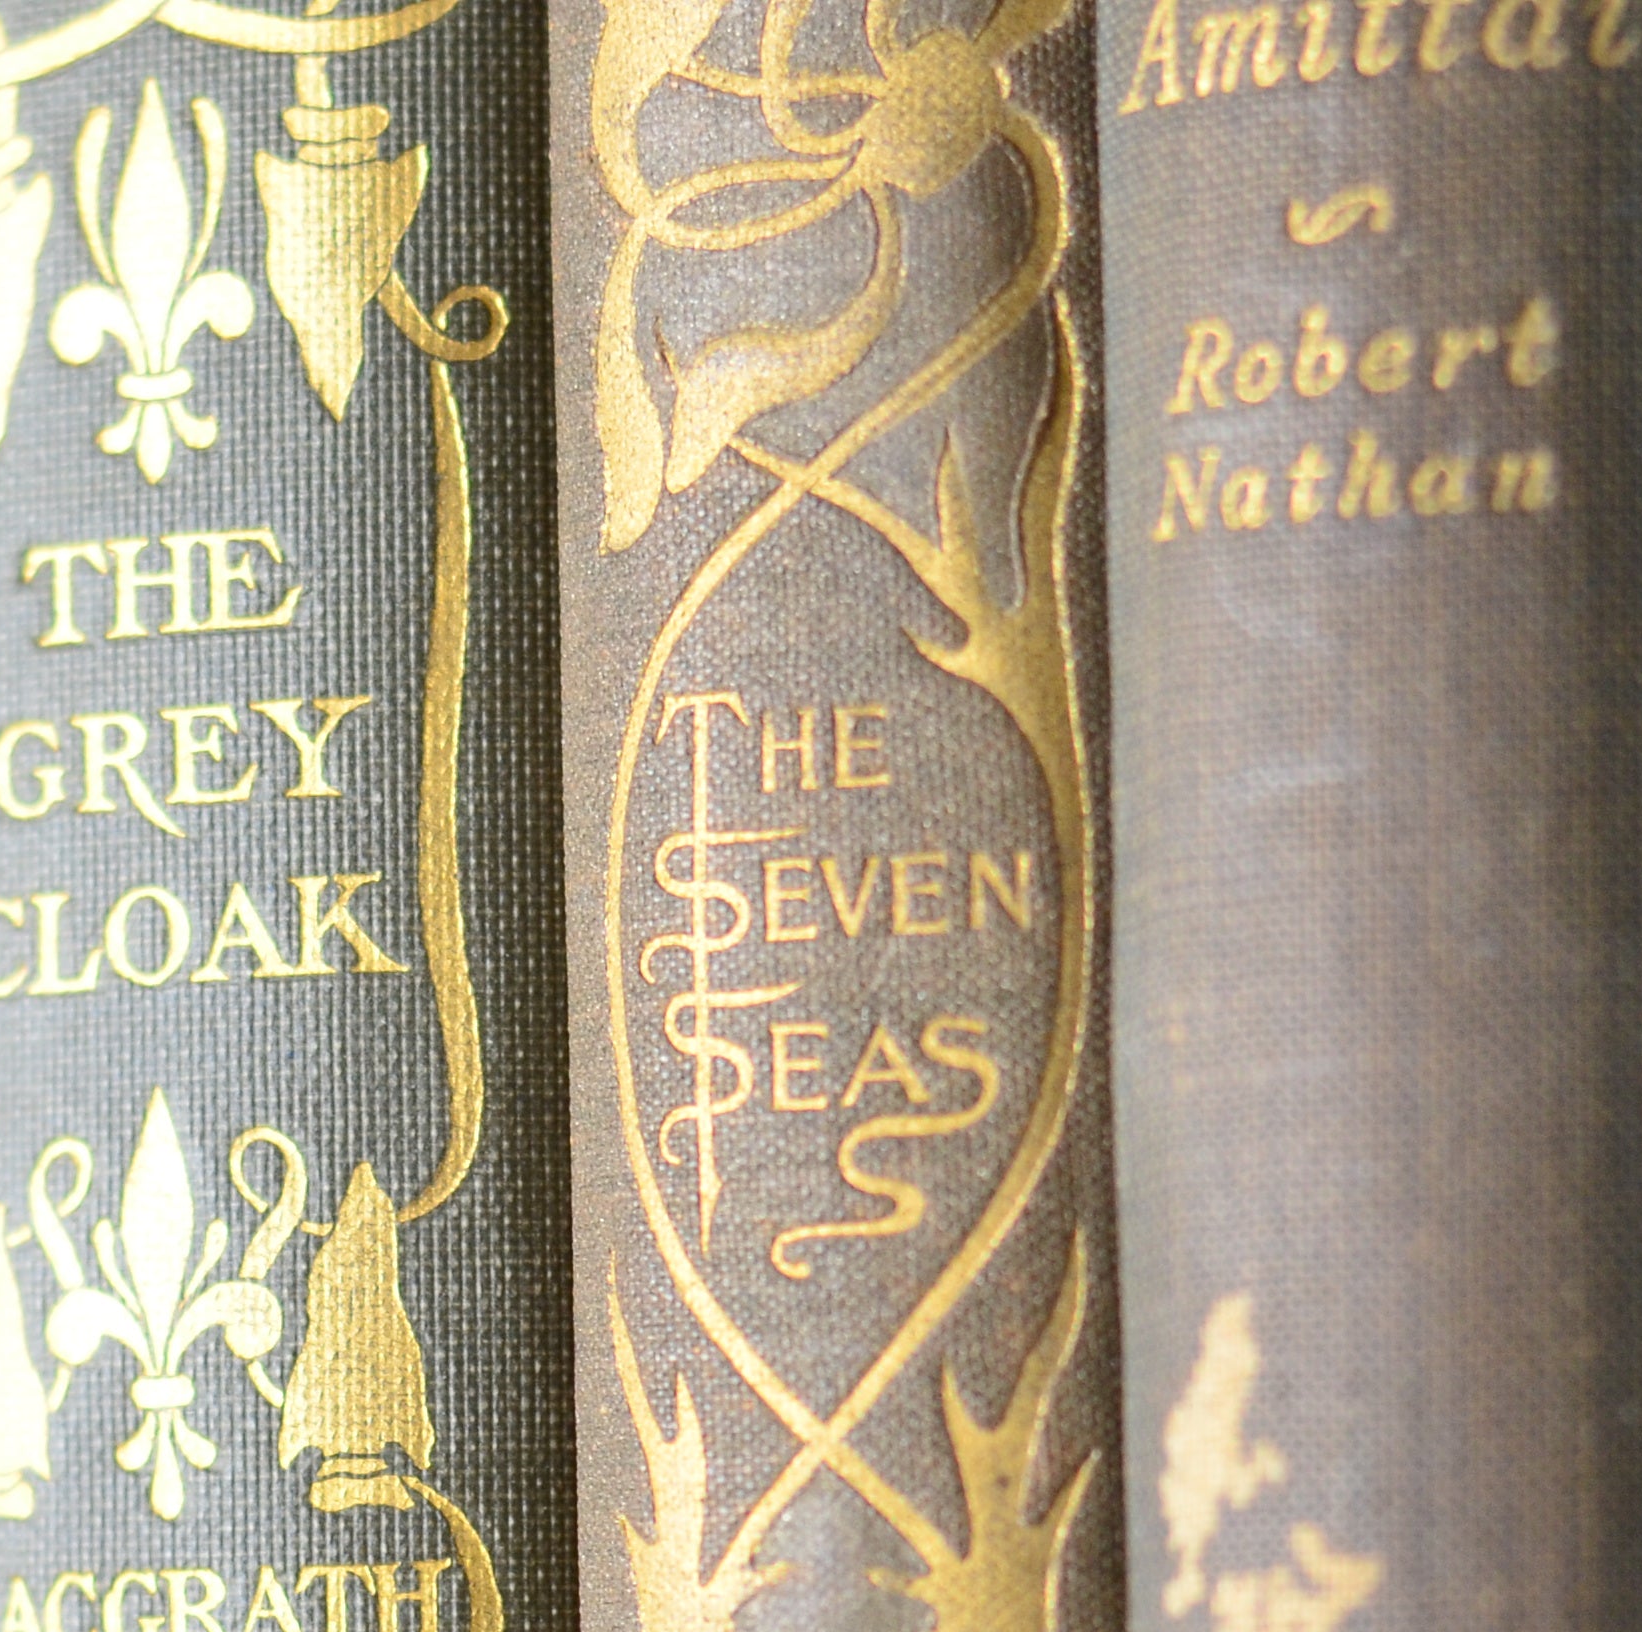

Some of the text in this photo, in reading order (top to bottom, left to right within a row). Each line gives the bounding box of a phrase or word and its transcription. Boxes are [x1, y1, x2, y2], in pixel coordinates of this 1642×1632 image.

[1167, 293, 1561, 416] Robert
[1150, 427, 1557, 543] Nathan
[21, 526, 304, 648] THE
[639, 824, 1034, 985] SEVEN
[658, 981, 1000, 1281] SEAS
